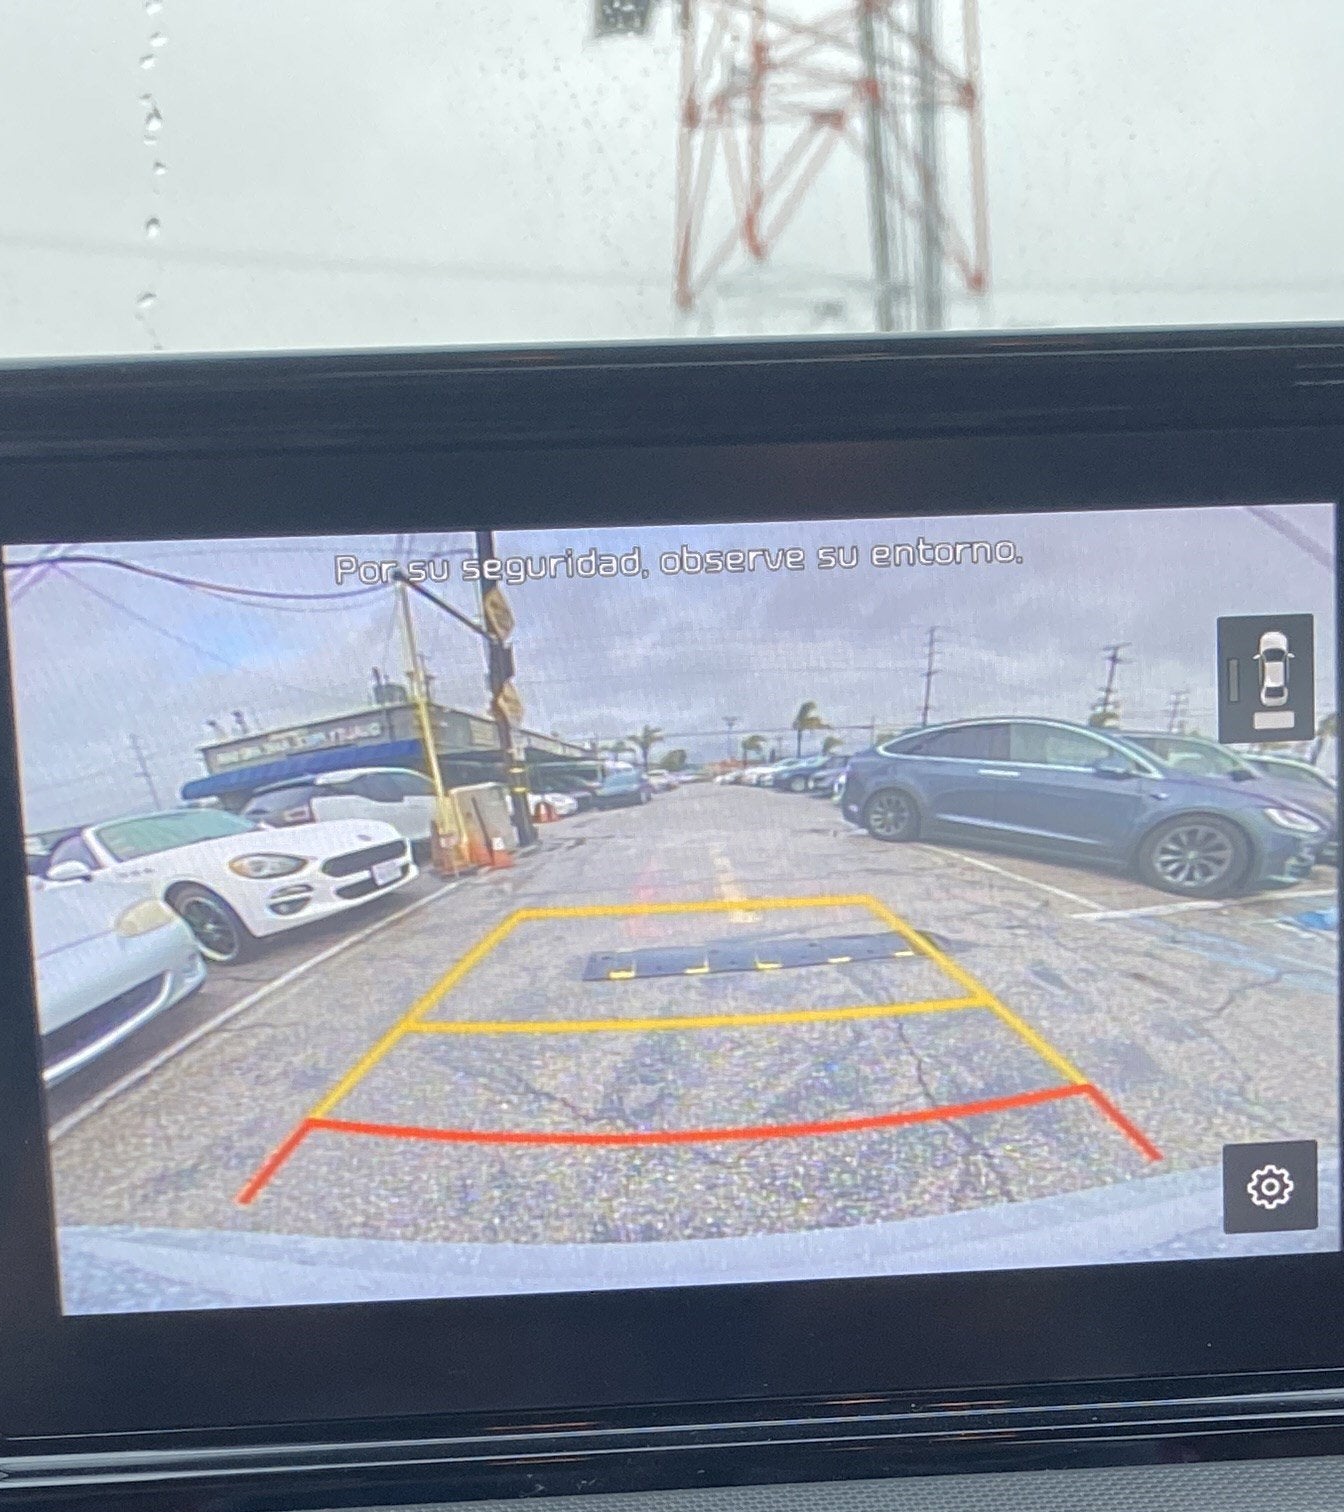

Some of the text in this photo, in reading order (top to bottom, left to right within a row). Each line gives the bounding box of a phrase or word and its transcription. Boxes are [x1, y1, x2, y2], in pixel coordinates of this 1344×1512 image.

[334, 537, 1024, 585] Por su seguridad, observe su entorno.
